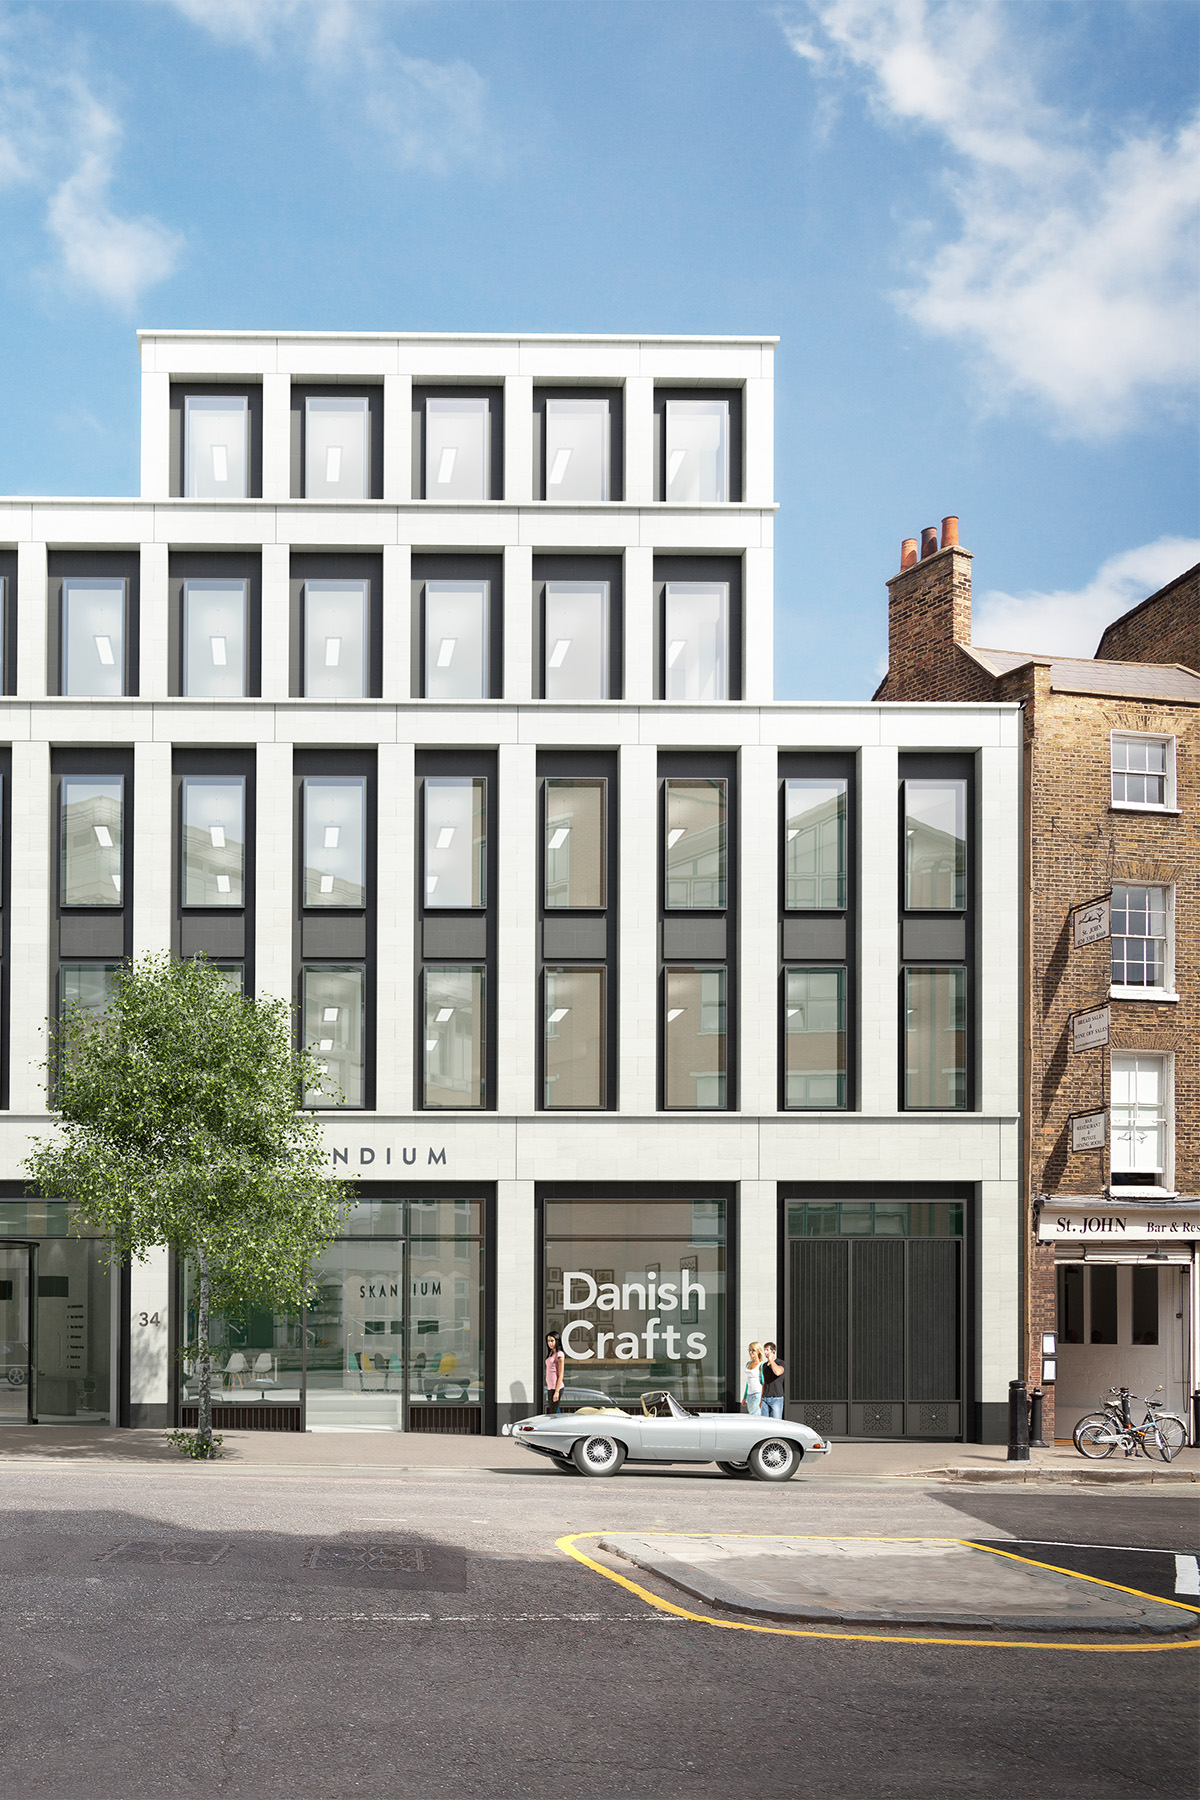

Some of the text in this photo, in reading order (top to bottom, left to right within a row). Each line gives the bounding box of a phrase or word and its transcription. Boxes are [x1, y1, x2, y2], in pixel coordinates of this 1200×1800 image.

[1077, 1013, 1105, 1026] BREAD SALES
[283, 1147, 446, 1164] NDIUM
[1056, 1217, 1076, 1232] St.
[1080, 1217, 1127, 1234] JOHN
[1147, 1221, 1166, 1232] Bar
[1169, 1221, 1179, 1232] &
[360, 1281, 441, 1298] SKANIUM
[563, 1269, 706, 1311] Danish
[139, 1312, 160, 1327] 34
[561, 1318, 708, 1360] Crafts
